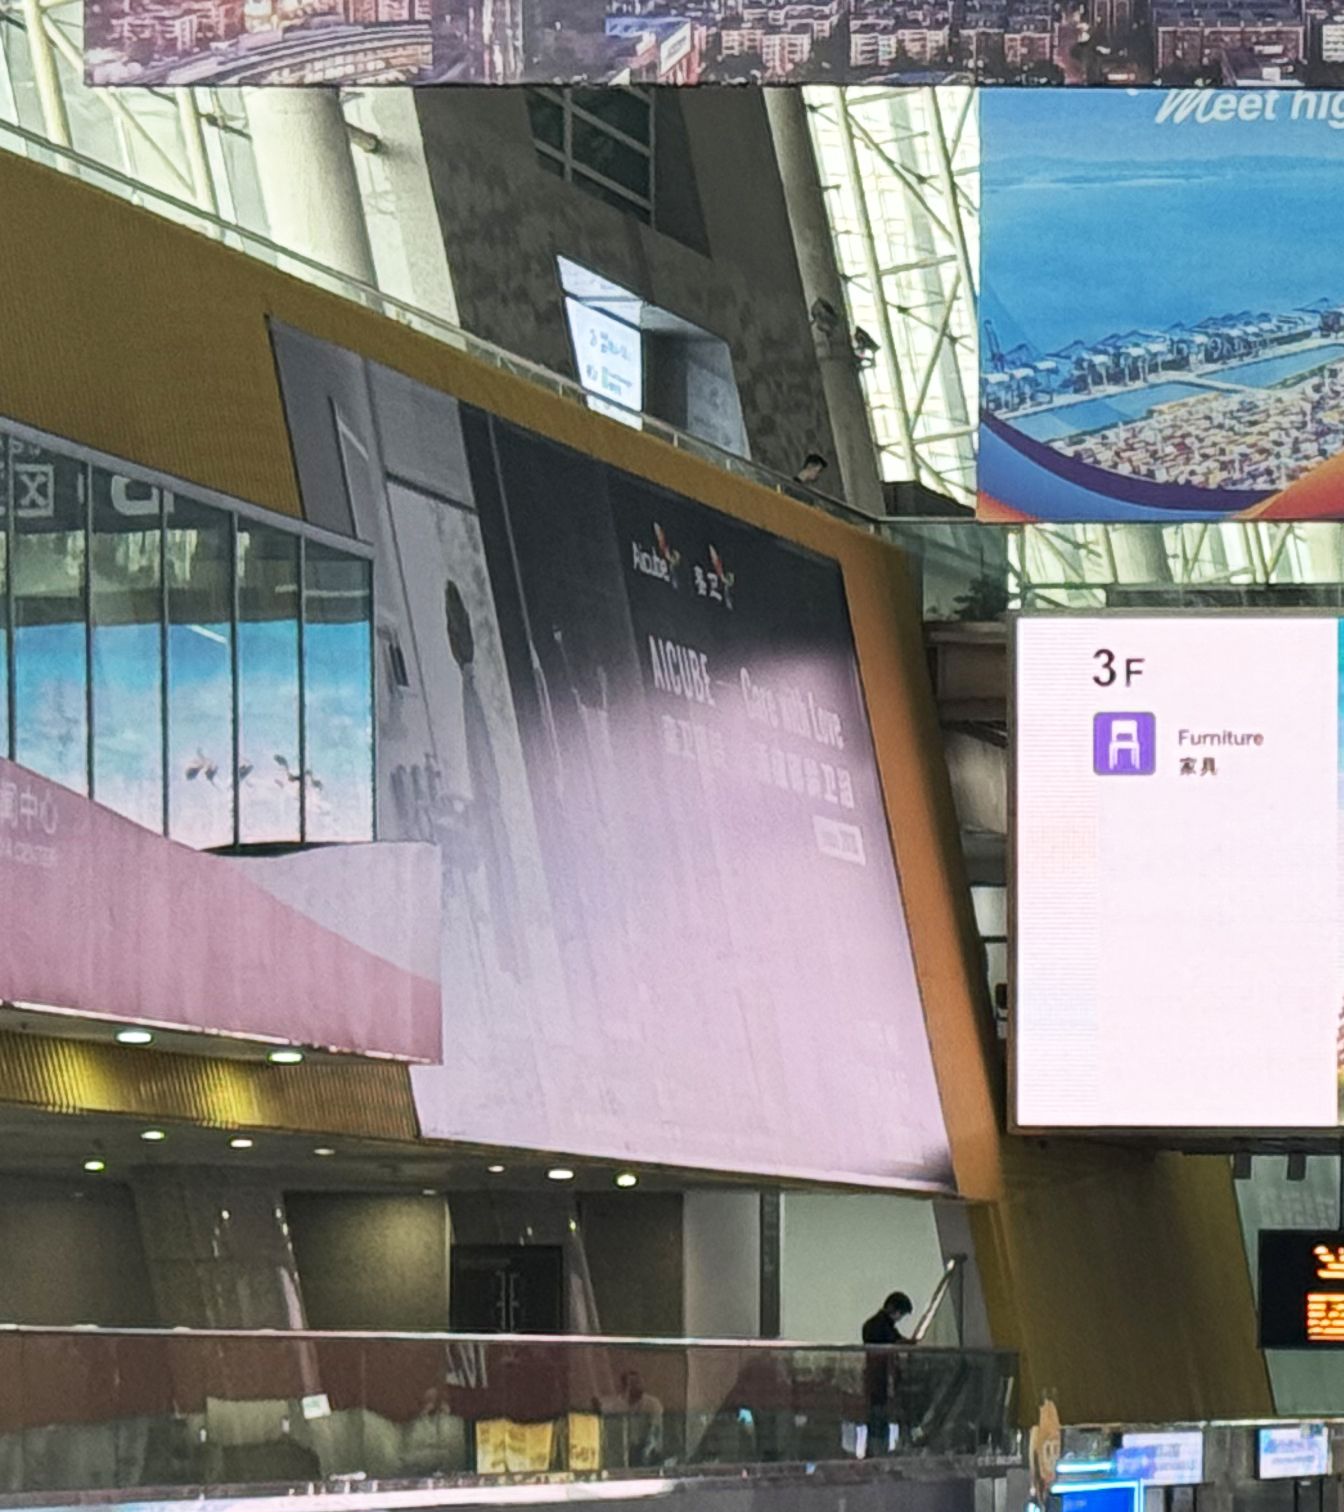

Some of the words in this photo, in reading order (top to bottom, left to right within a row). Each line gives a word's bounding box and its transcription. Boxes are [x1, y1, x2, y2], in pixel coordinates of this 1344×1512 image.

[1153, 92, 1279, 125] Meet
[1092, 648, 1146, 688] 3F
[1178, 729, 1265, 746] Furniture
[1179, 757, 1217, 776] 家具
